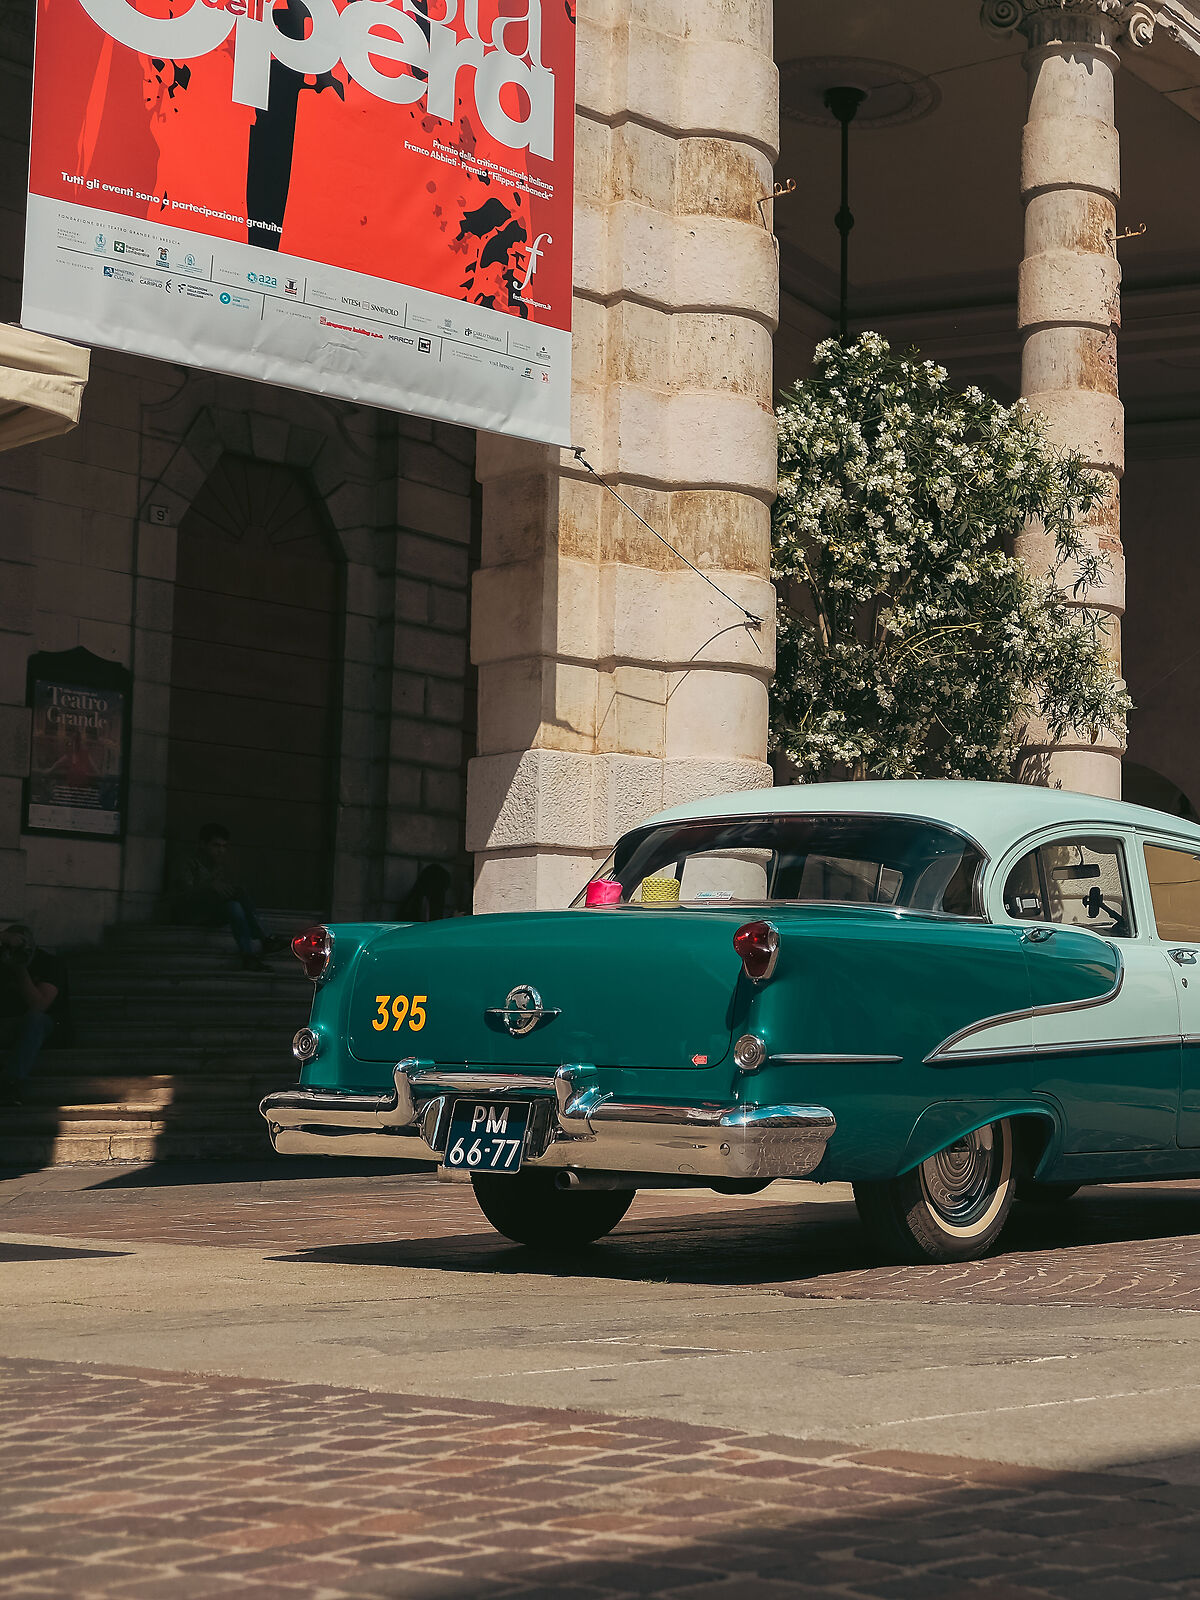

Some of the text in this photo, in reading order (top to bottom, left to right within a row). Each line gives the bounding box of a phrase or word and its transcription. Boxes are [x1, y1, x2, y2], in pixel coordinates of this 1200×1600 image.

[404, 140, 429, 156] Franco
[430, 150, 457, 167] Abbiati
[461, 161, 488, 178] Premio
[432, 139, 554, 192] Premio della critica musicale italiana
[61, 171, 283, 234] Tutti gli eventi sono a partecipazione gratuita
[139, 279, 163, 290] CARIPLO
[258, 274, 278, 286] a2a
[341, 296, 361, 308] INTESA
[388, 334, 414, 345] MARCO
[48, 685, 109, 713] Teatro
[46, 705, 108, 730] Grande
[372, 994, 428, 1032] 395
[470, 1105, 510, 1134] PM
